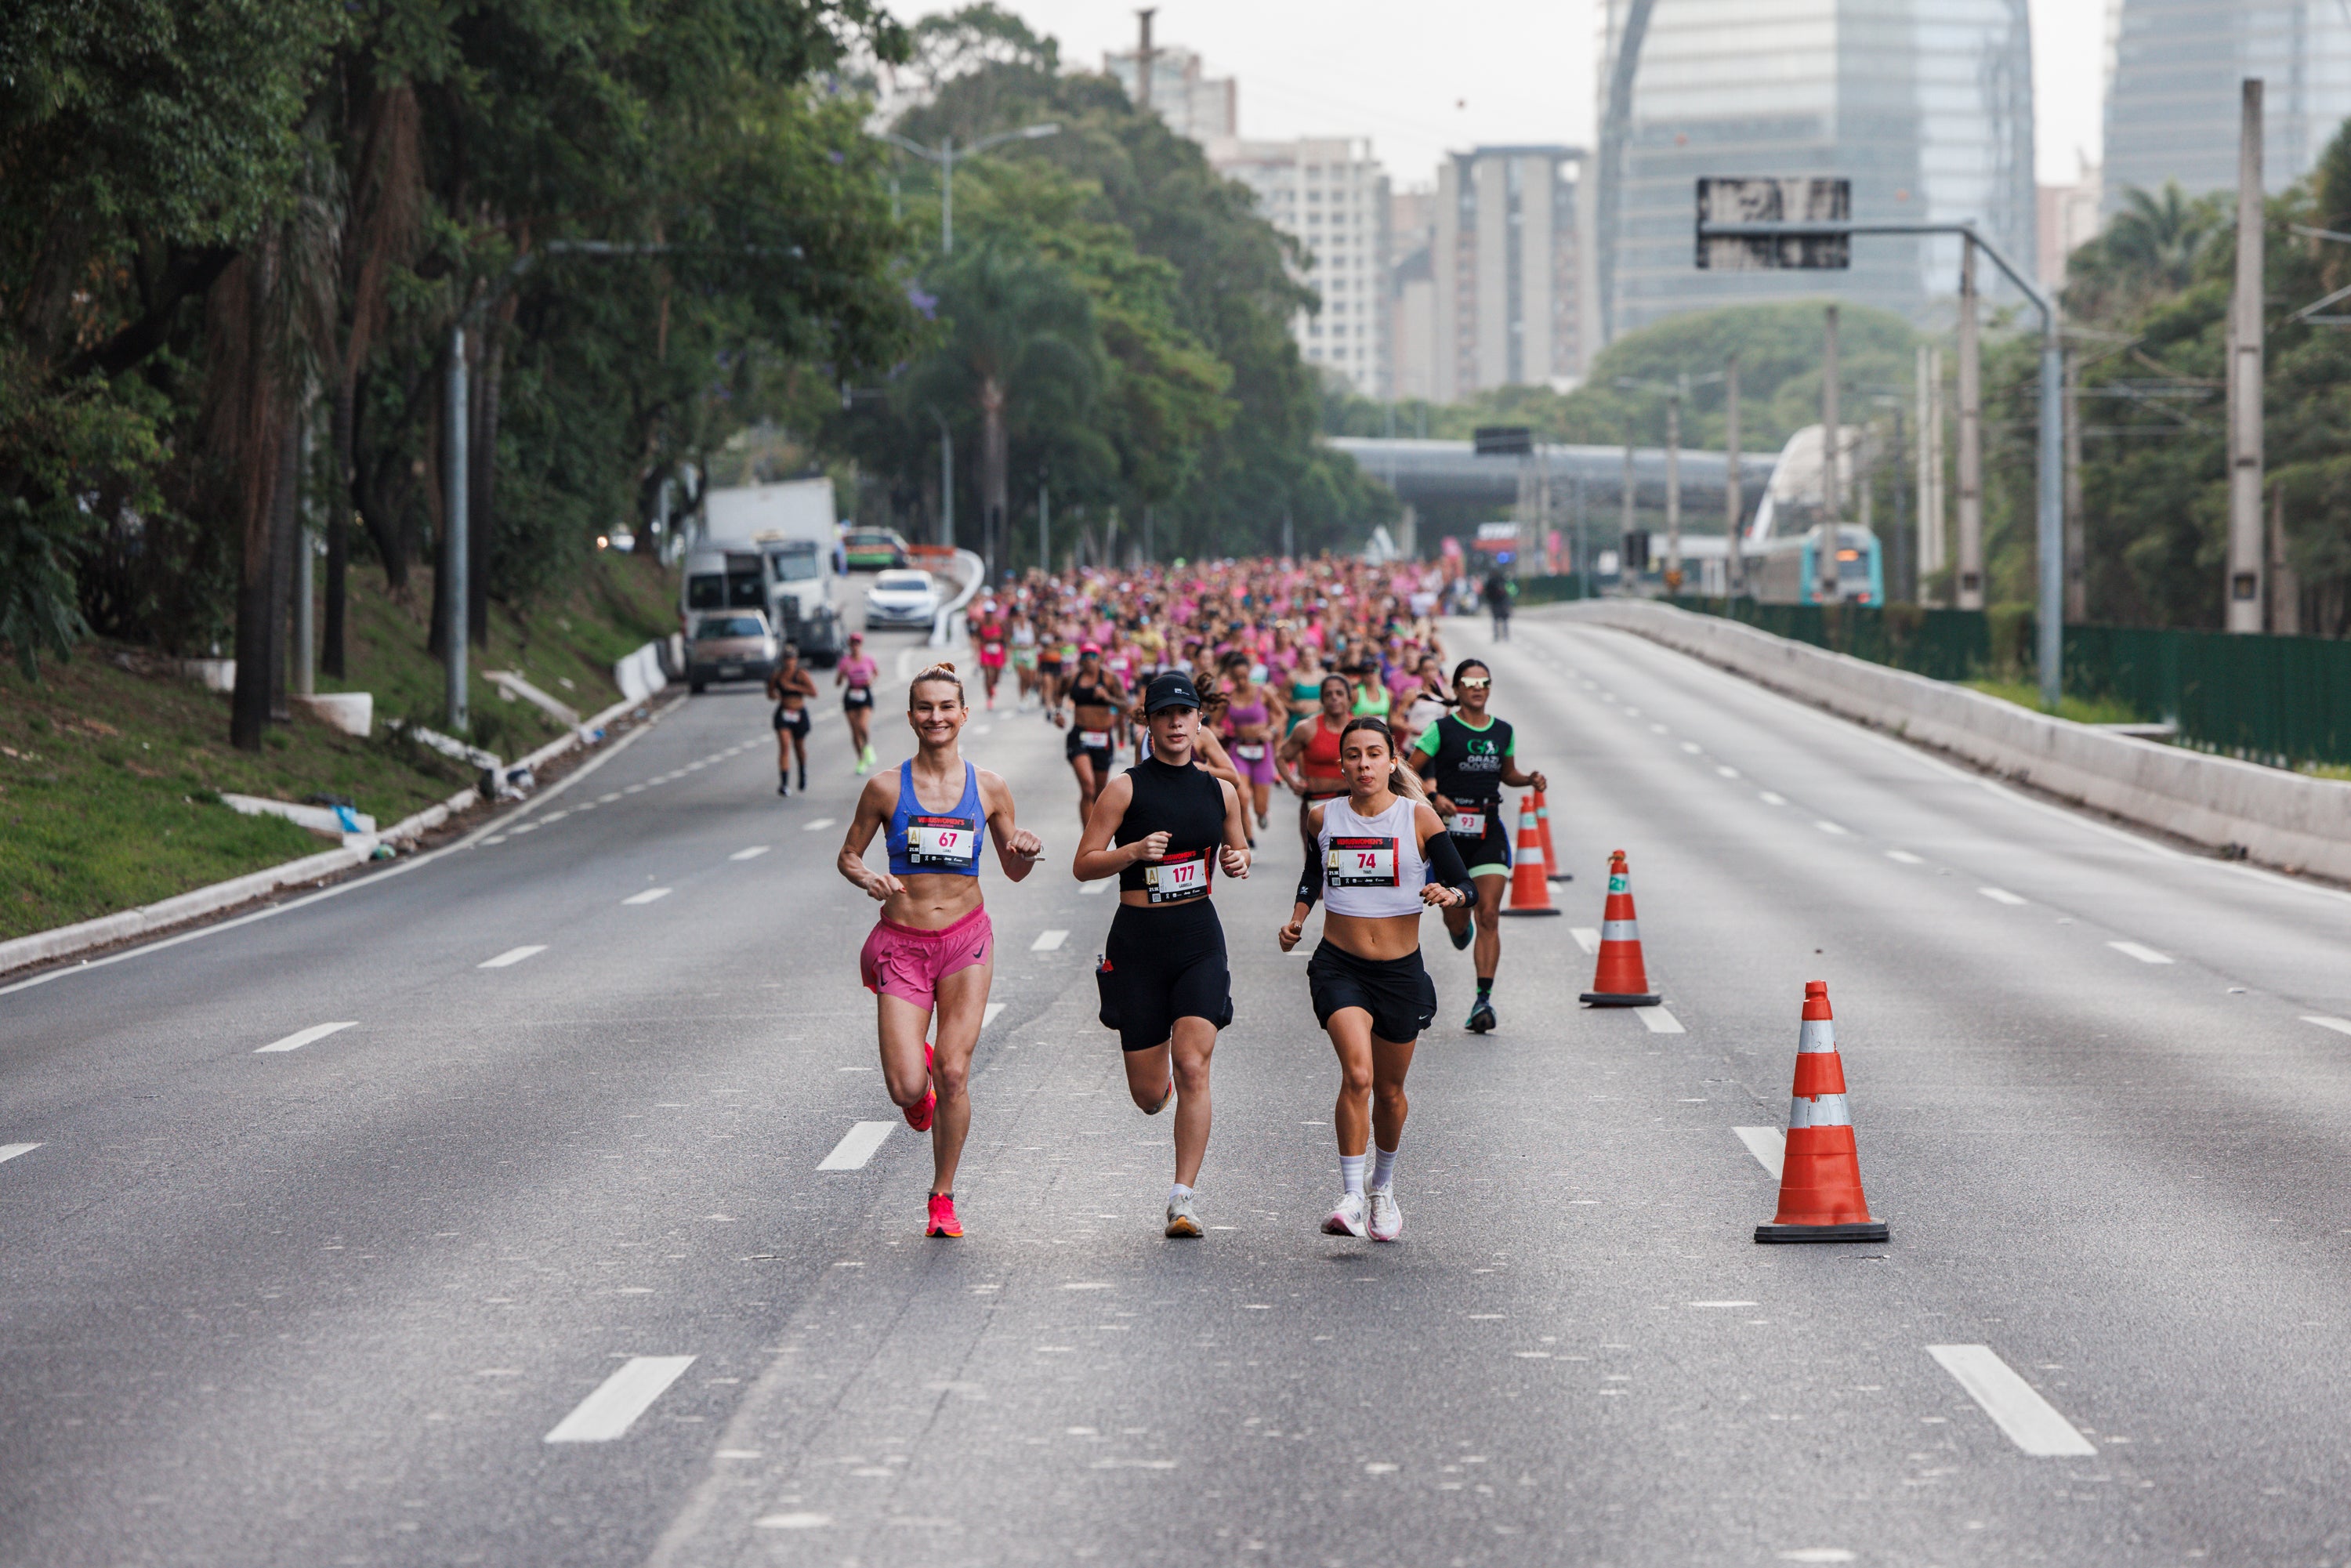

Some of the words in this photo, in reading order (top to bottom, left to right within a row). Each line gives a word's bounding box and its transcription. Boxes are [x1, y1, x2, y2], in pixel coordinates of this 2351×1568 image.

[1462, 817, 1475, 827] 93
[911, 830, 917, 842] A
[939, 832, 958, 847] 67
[1331, 853, 1336, 865] A
[1357, 853, 1376, 868] 74
[1150, 870, 1156, 882] A
[1173, 865, 1194, 882] 177
